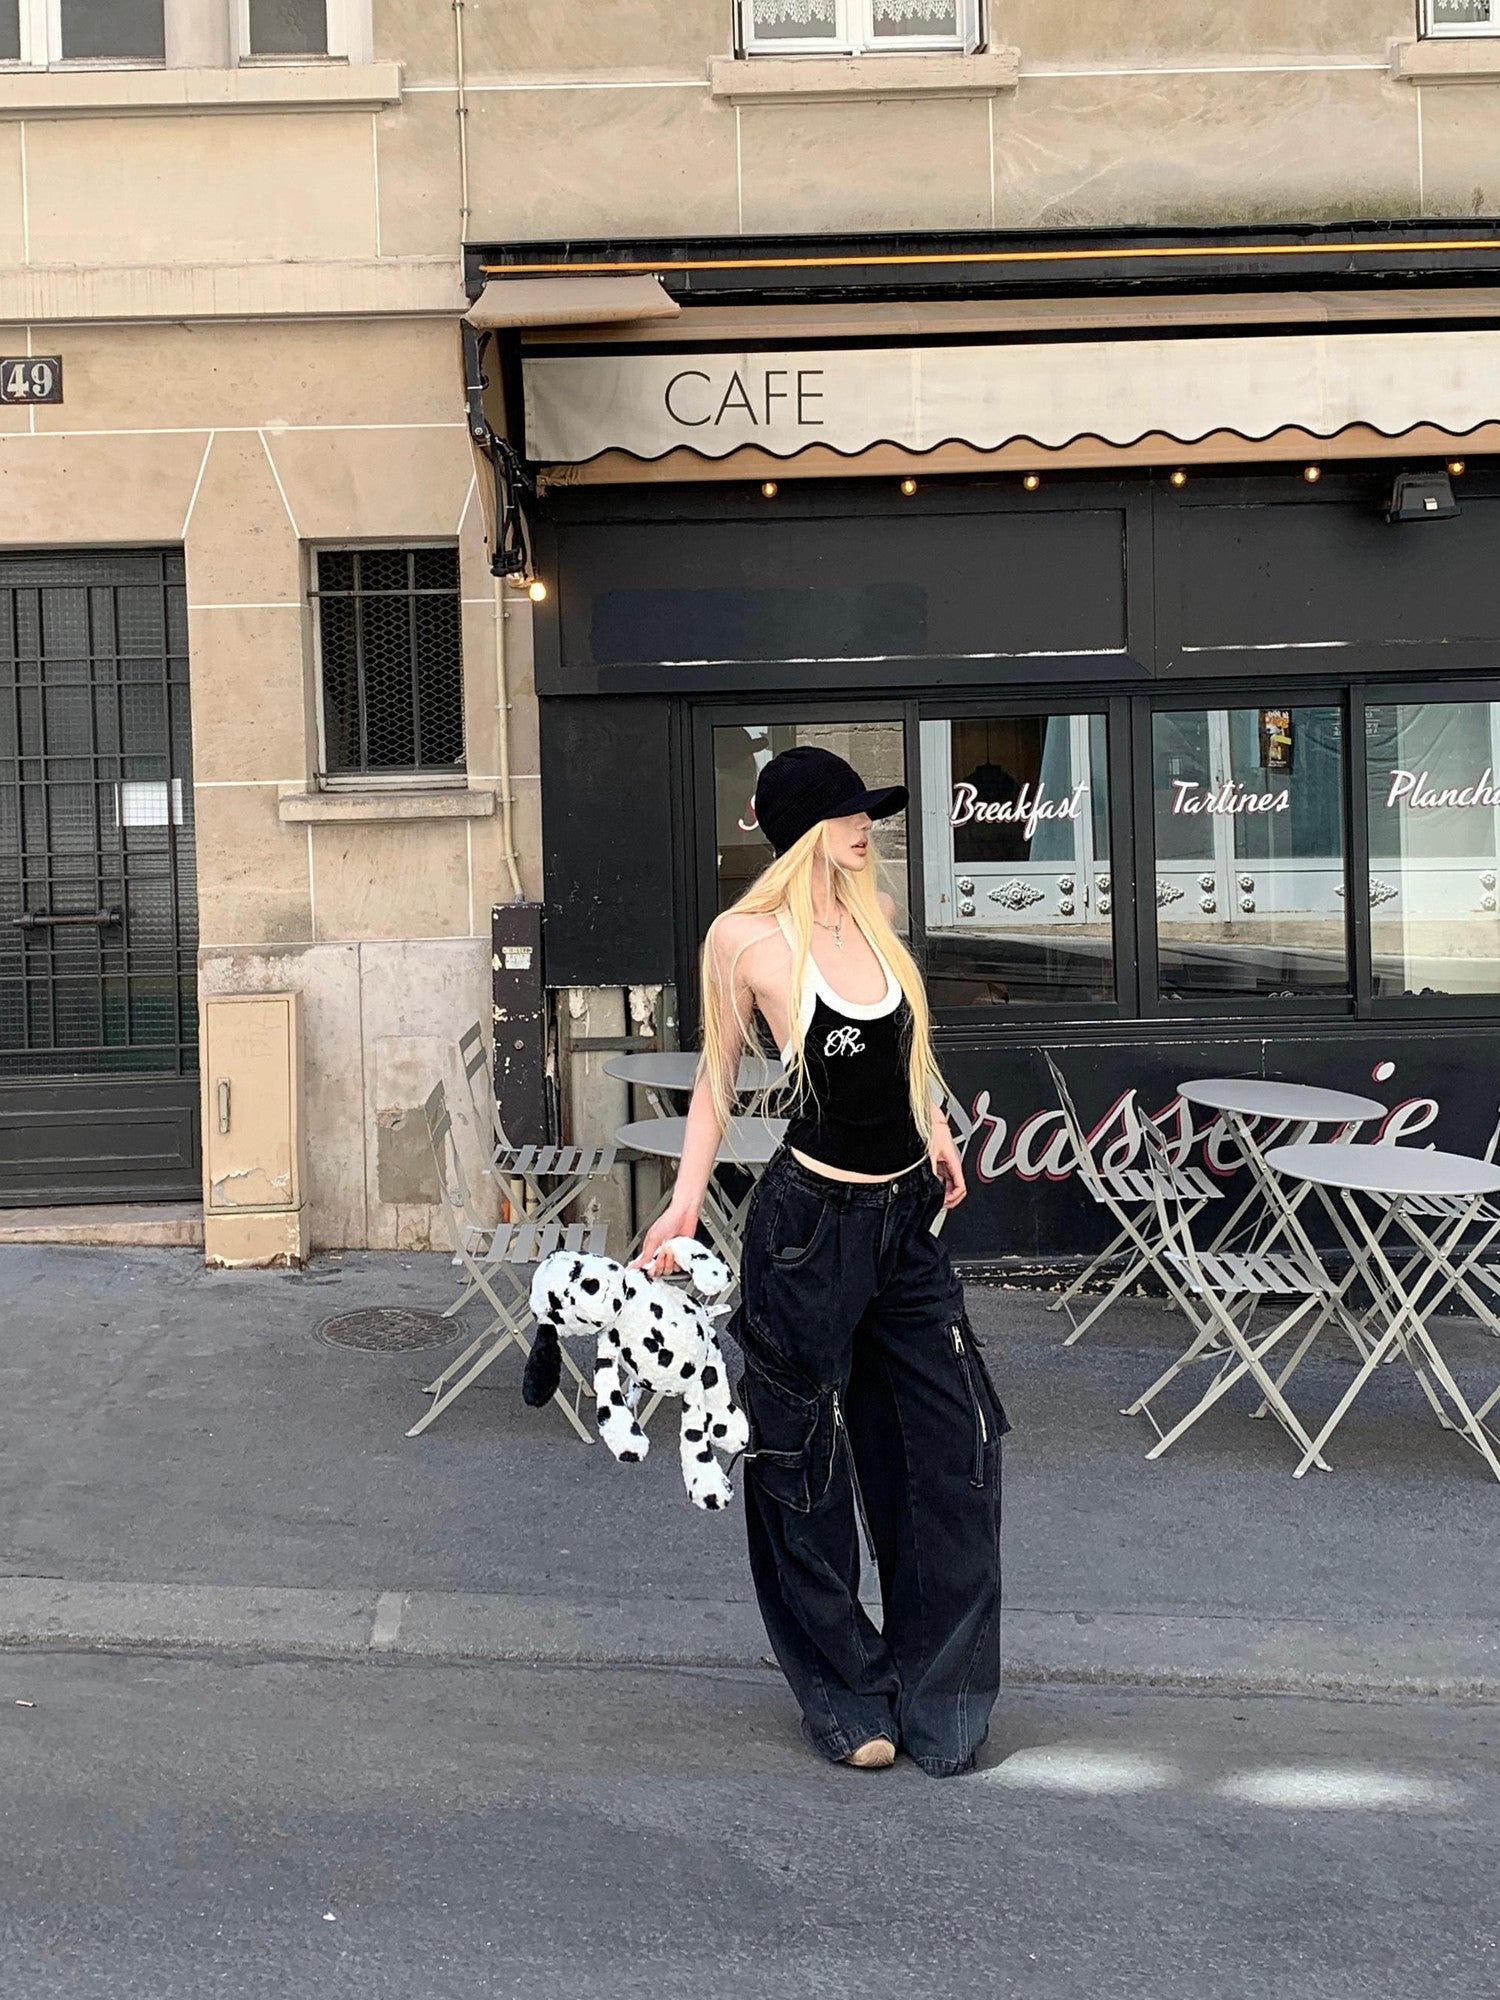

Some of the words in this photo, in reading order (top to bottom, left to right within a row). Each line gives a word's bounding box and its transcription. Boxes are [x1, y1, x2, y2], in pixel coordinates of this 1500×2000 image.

[7, 363, 53, 398] 49
[665, 369, 825, 427] CAFE
[950, 779, 1089, 841] Breakfast
[1172, 779, 1290, 816] Tartines
